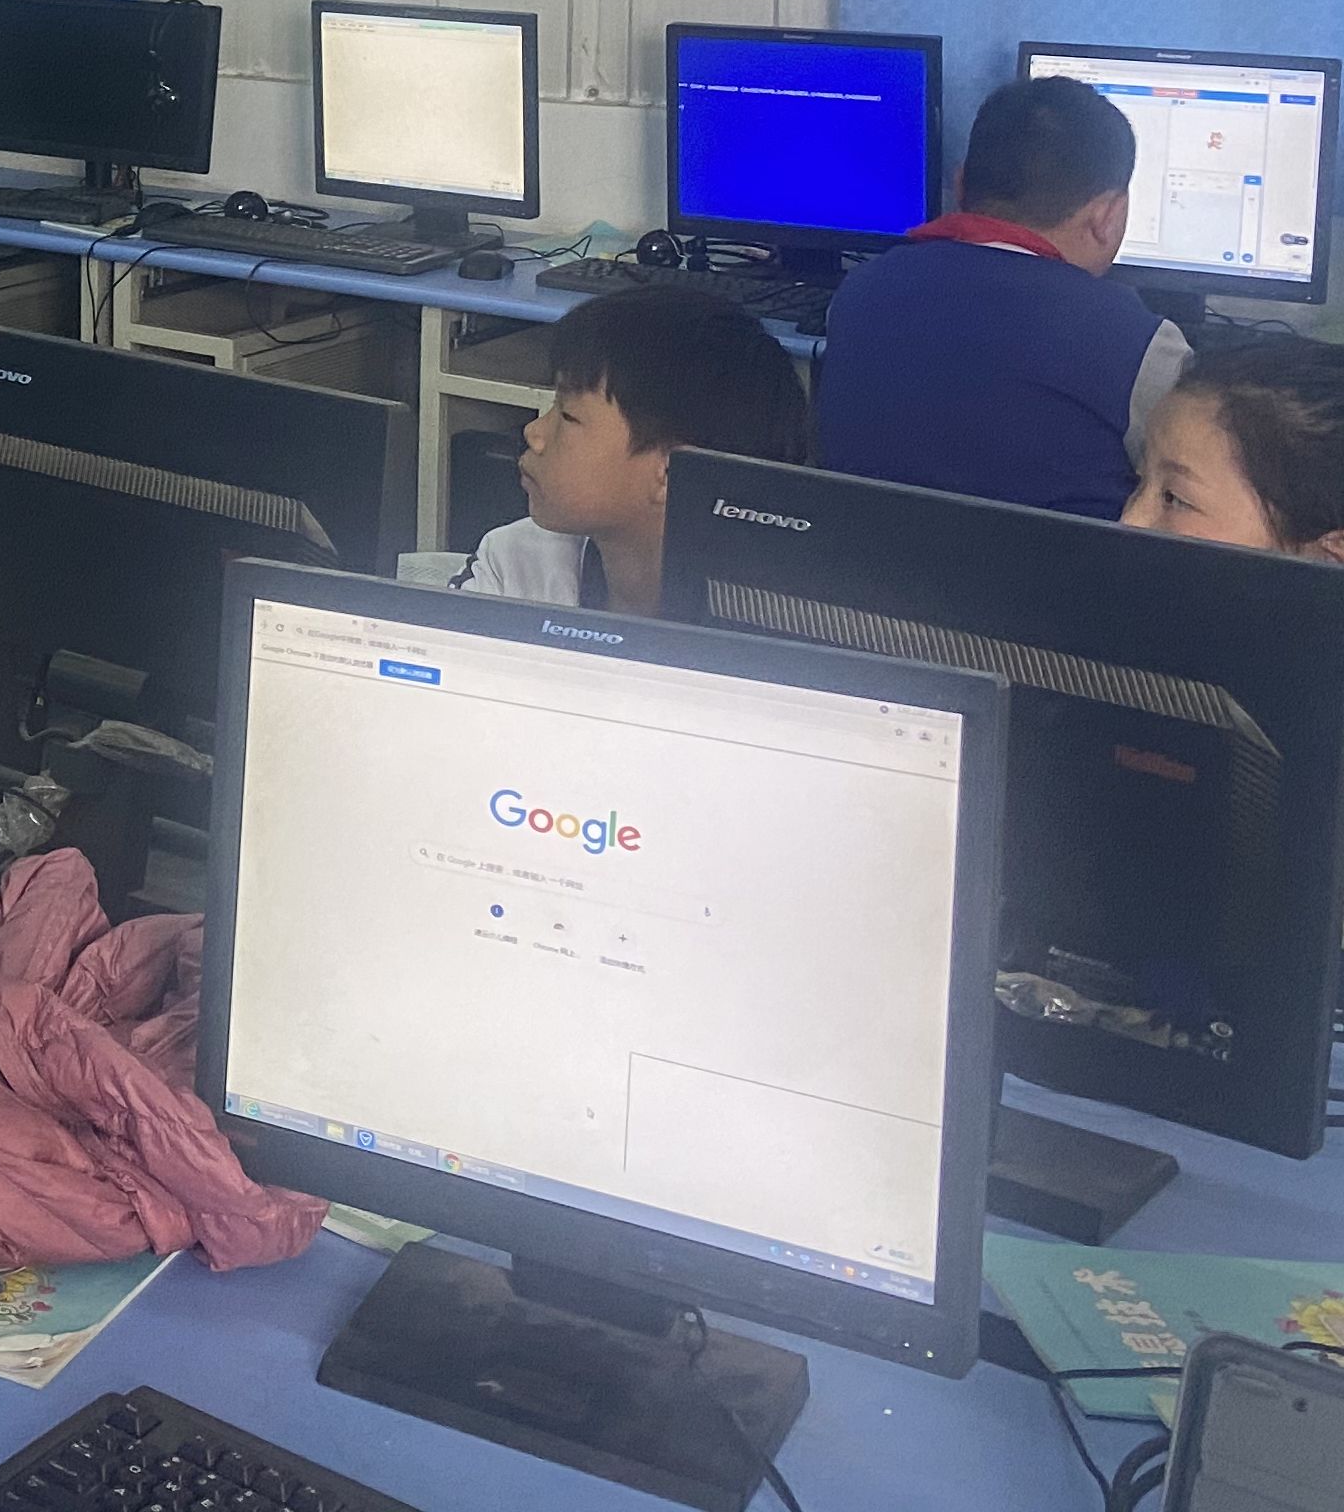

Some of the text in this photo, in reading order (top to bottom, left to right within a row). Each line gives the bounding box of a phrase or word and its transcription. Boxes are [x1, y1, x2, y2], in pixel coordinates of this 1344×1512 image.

[713, 499, 812, 531] lenovo
[542, 620, 624, 644] lenovo
[490, 789, 641, 855] Google
